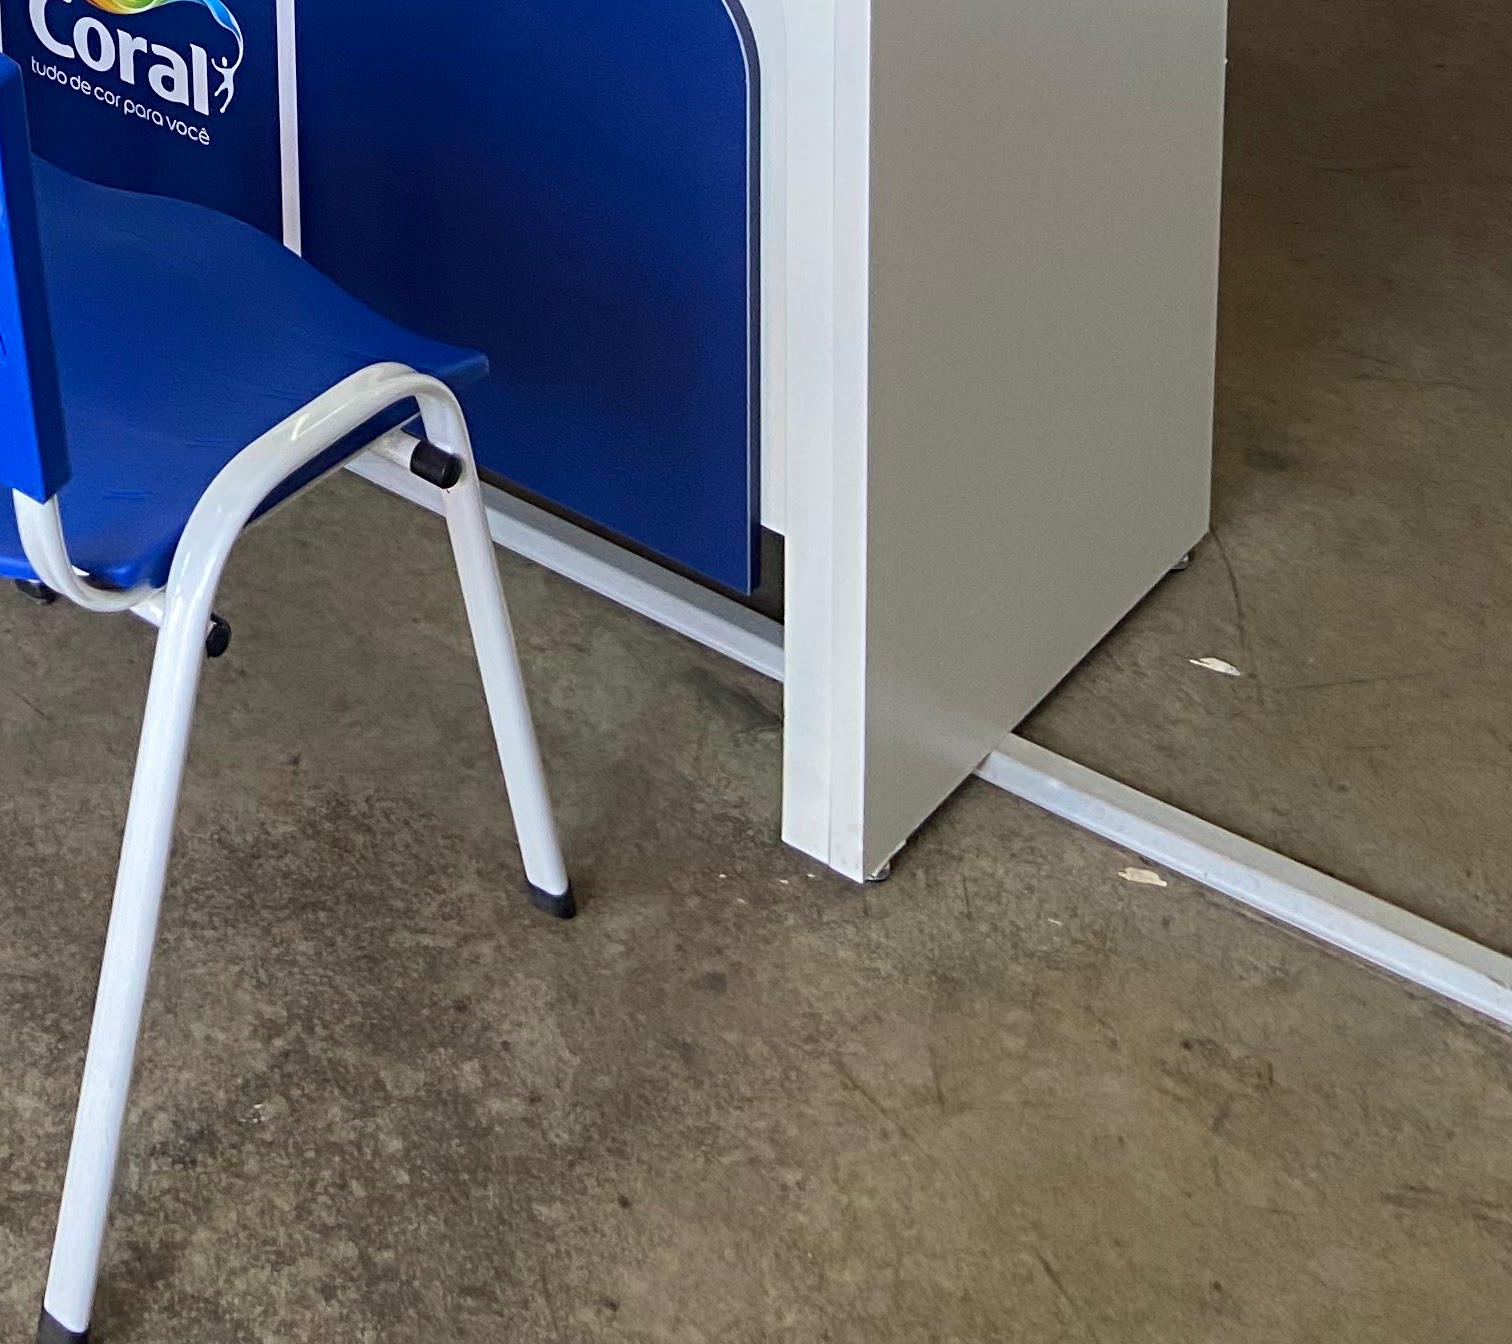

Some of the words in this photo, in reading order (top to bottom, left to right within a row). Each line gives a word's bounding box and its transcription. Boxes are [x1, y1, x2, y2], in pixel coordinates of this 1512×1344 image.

[31, 55, 68, 85] tudo
[70, 74, 92, 96] de
[93, 87, 120, 108] cor
[124, 99, 163, 128] para
[166, 114, 210, 146] você
